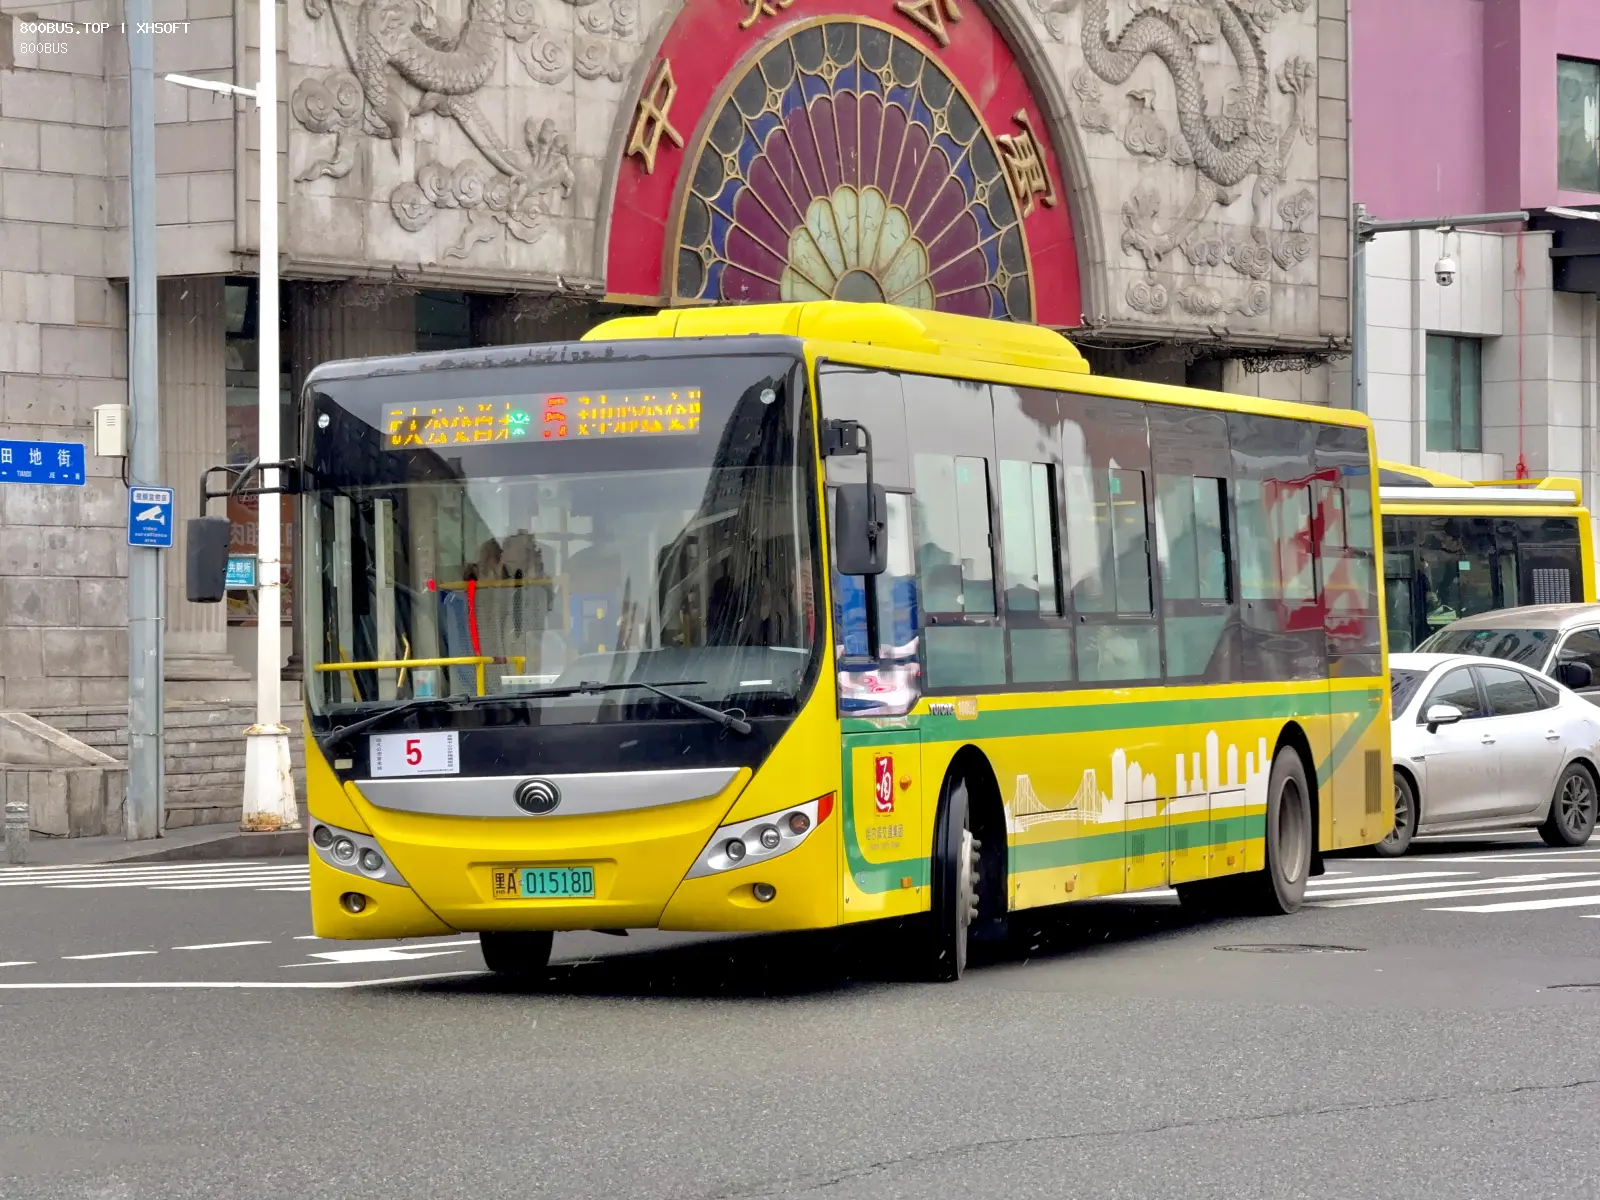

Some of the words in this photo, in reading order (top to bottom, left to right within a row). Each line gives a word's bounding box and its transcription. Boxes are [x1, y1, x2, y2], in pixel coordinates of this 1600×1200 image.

[1, 447, 71, 468] 田地街
[406, 738, 423, 766] 5
[526, 871, 593, 894] 01518D
